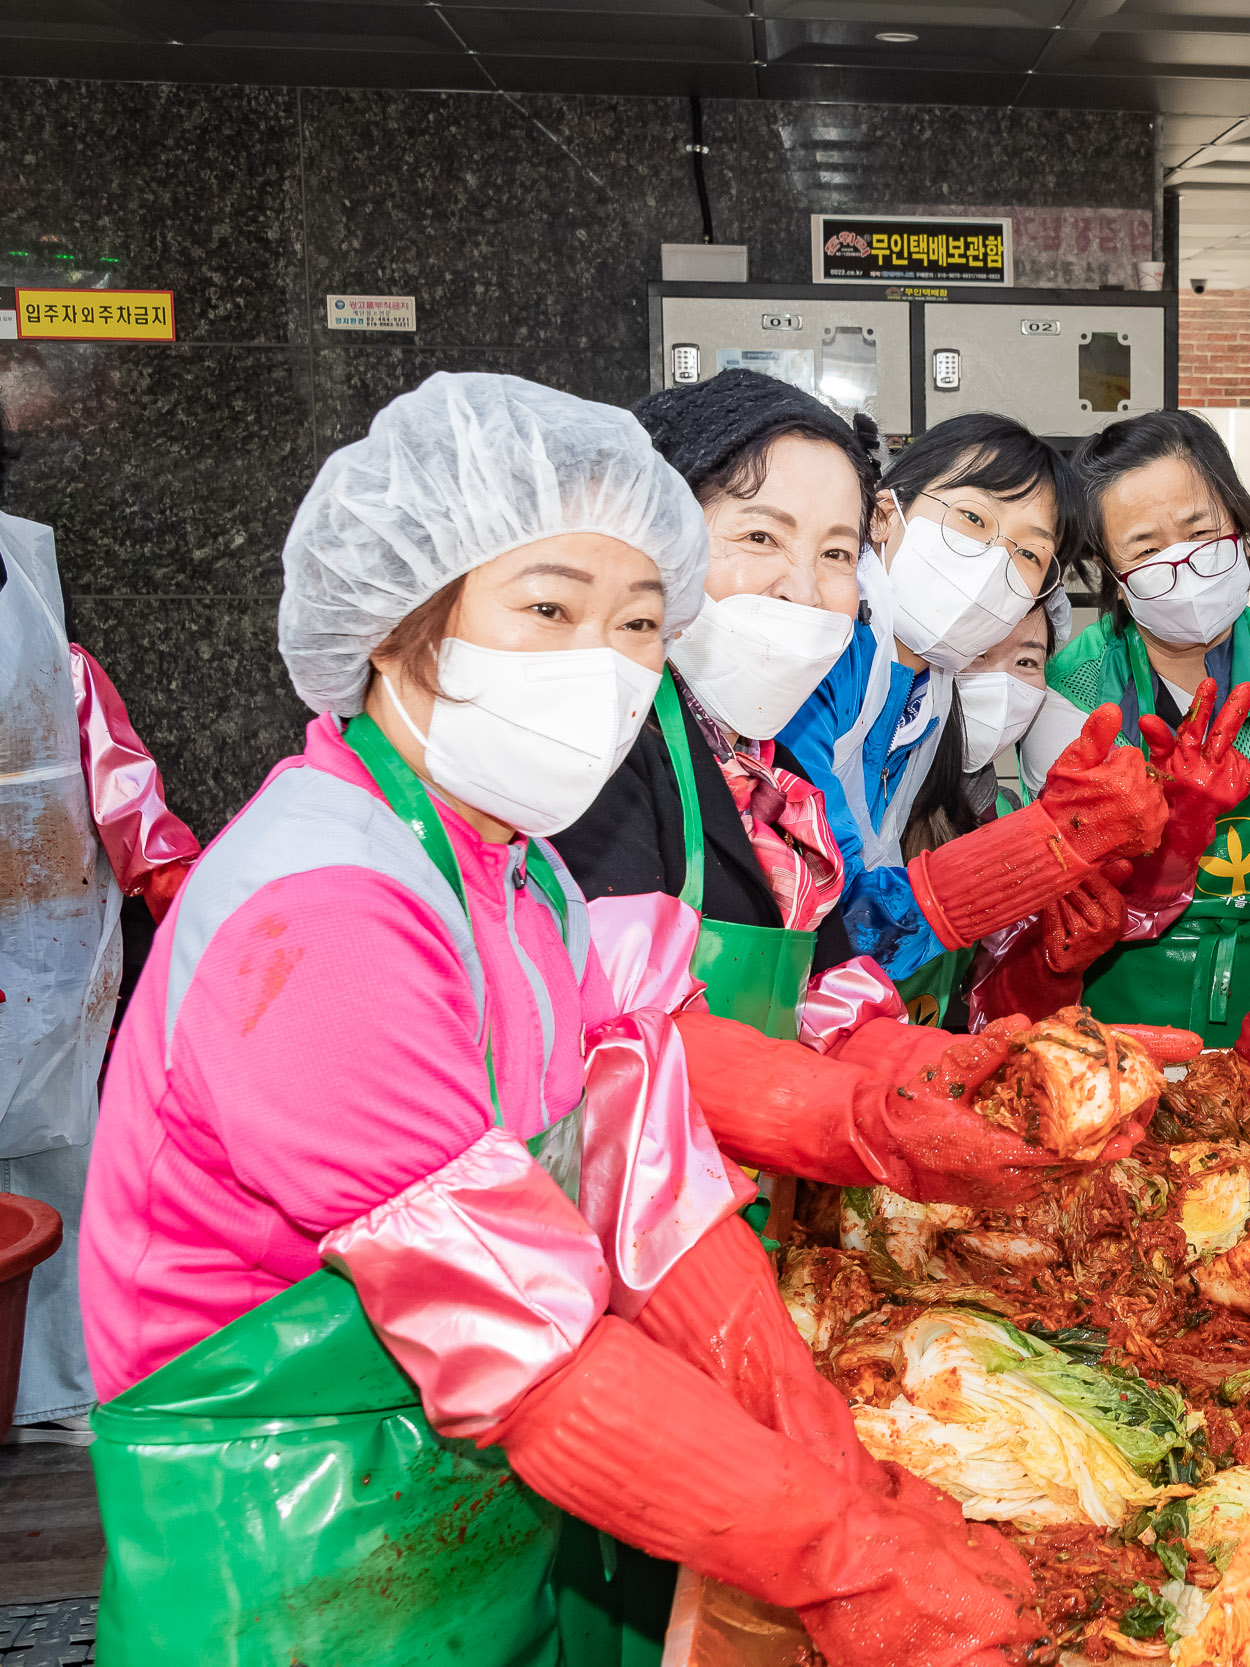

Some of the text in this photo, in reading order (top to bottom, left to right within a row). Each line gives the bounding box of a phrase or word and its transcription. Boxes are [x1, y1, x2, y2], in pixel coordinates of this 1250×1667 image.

[871, 233, 1004, 268] 무인택배보관함
[26, 303, 167, 326] 입주자외주차금지
[770, 318, 792, 327] 01
[1029, 323, 1052, 331] 02
